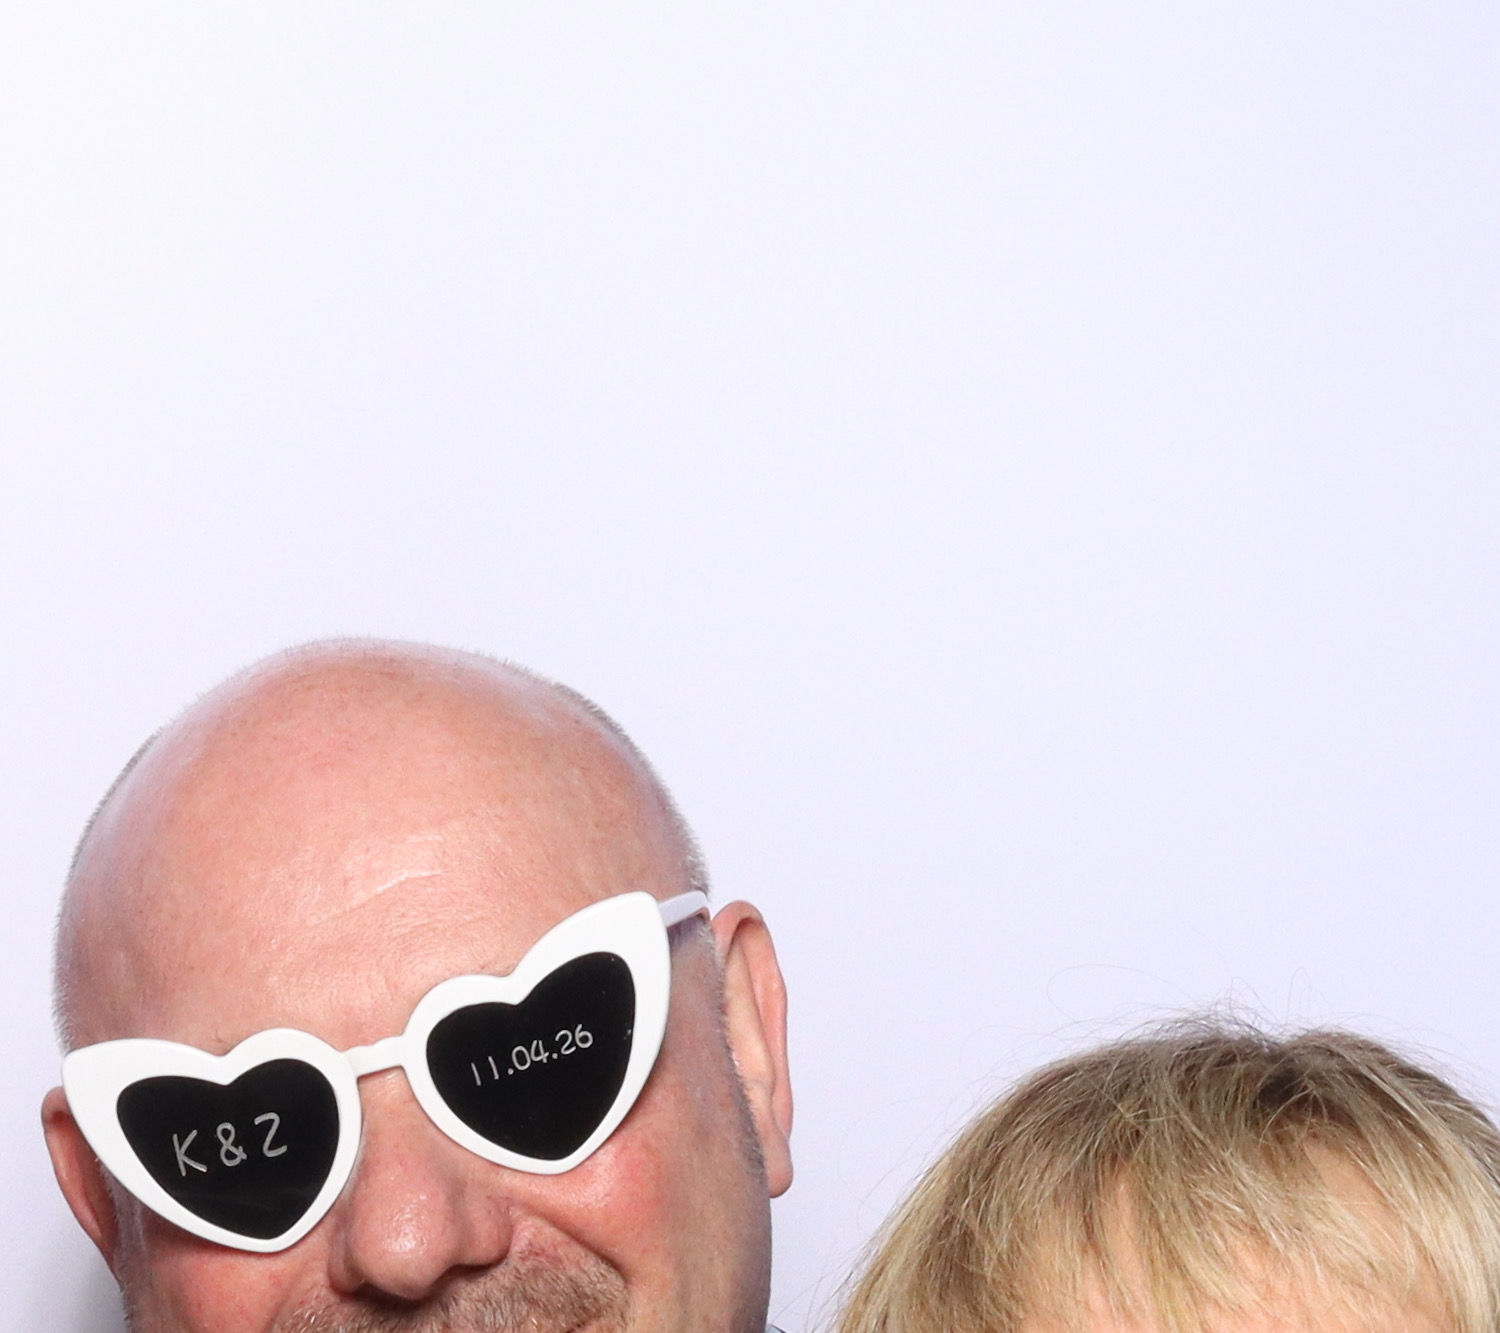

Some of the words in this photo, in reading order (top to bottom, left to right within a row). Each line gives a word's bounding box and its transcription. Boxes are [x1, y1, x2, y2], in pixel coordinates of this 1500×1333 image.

[469, 1021, 595, 1087] 11.04.26
[171, 1128, 209, 1178] K
[215, 1121, 248, 1168] &
